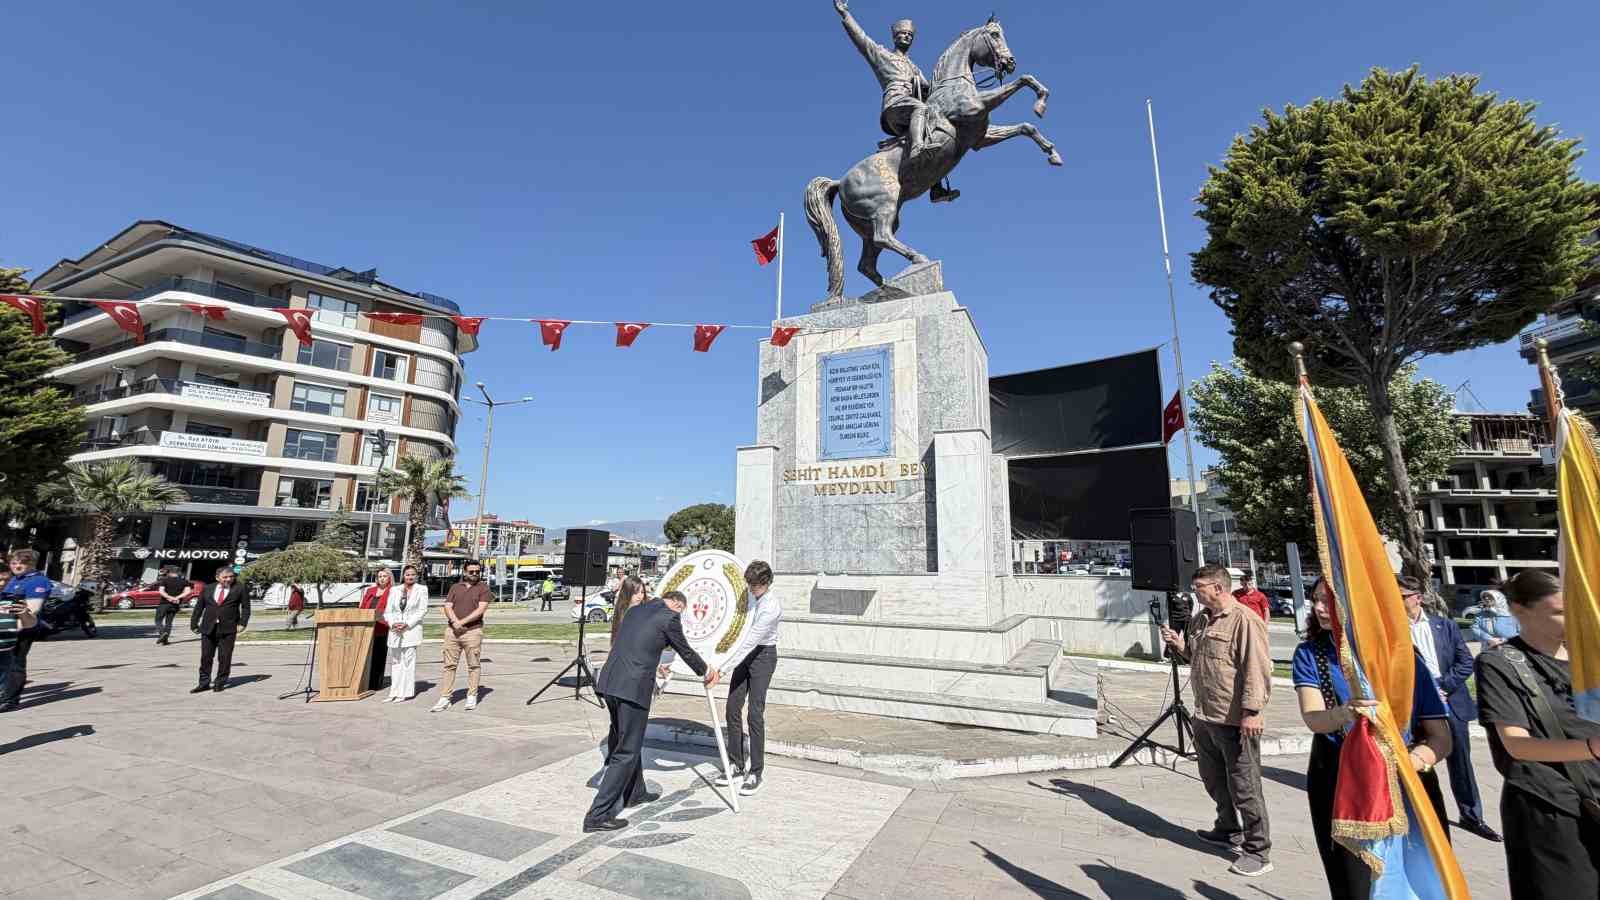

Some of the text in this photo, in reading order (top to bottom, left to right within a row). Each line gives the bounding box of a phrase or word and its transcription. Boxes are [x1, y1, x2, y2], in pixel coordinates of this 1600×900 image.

[828, 461, 886, 480] HAMDİ
[900, 463, 929, 477] BEY
[814, 480, 896, 497] MEYDANI
[154, 550, 177, 558] NC
[178, 550, 229, 560] MOTOR
